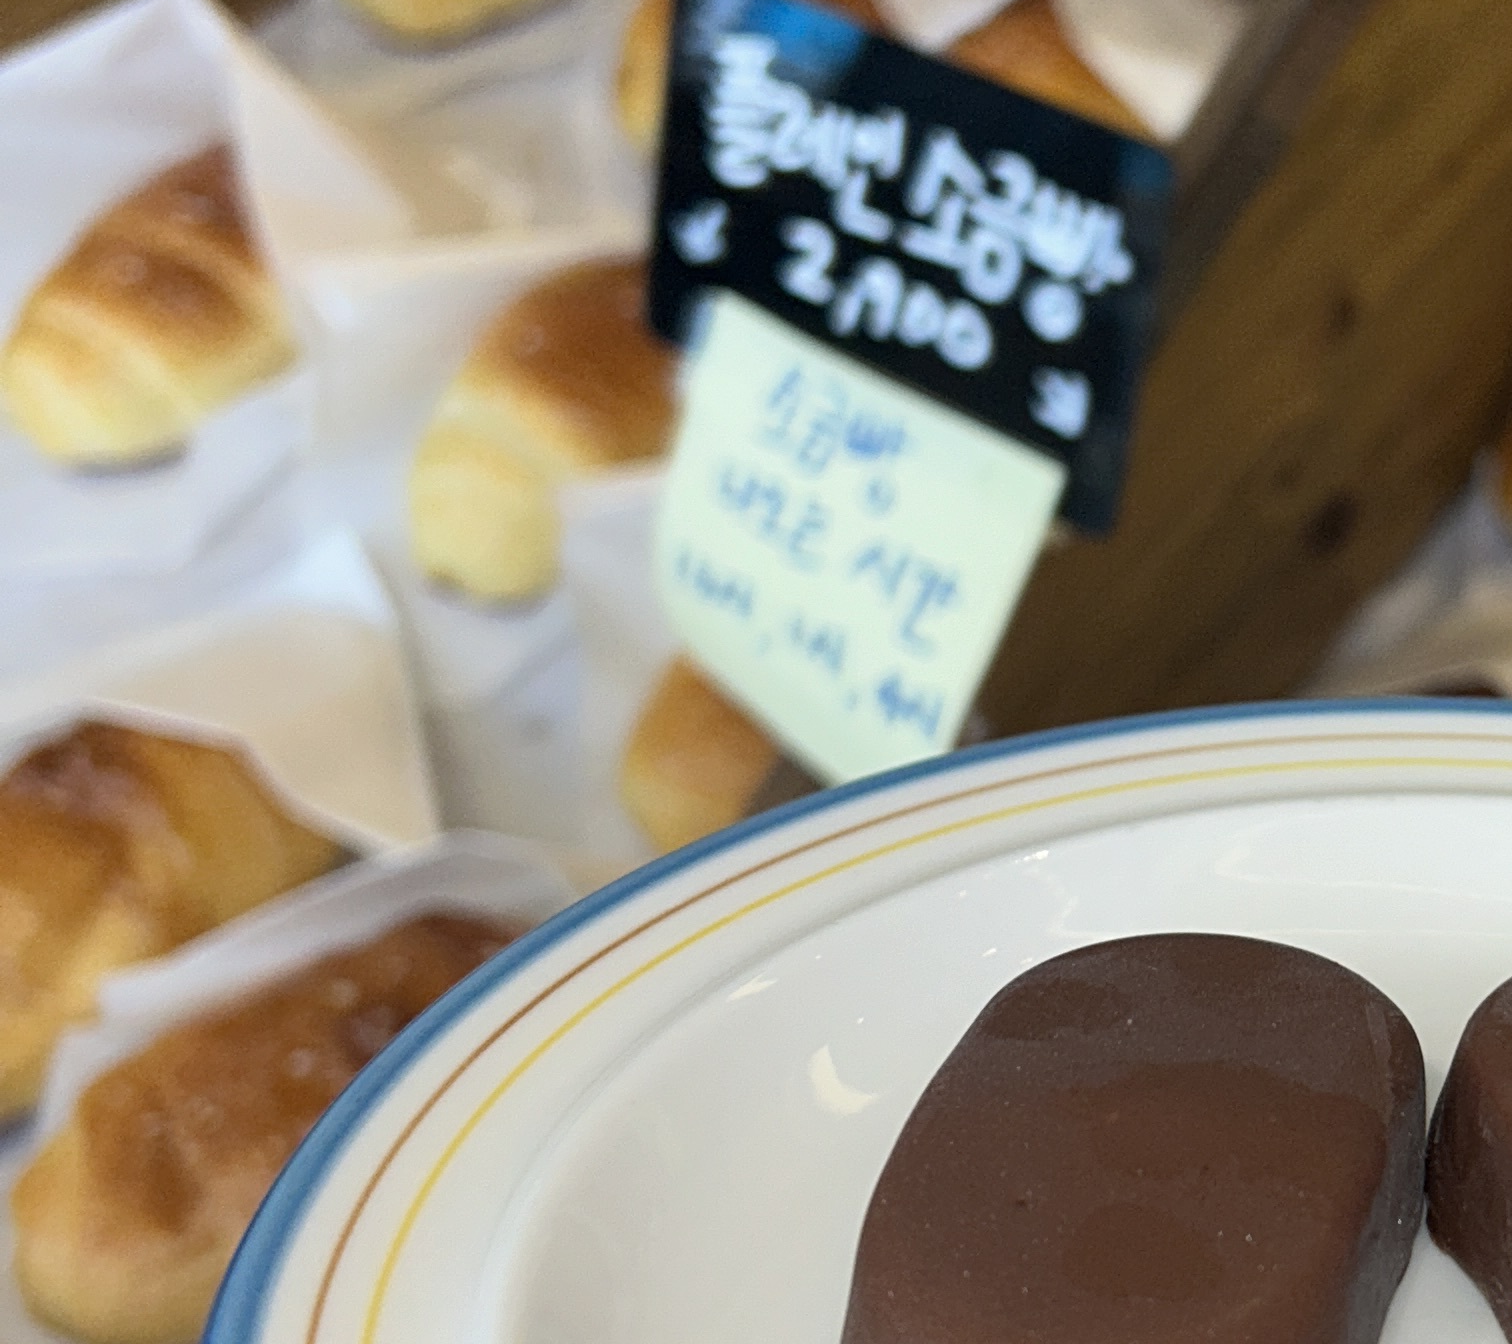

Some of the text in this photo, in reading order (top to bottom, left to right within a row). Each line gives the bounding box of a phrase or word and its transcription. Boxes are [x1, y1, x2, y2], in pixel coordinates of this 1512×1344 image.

[898, 126, 1136, 344] 소금빵
[760, 366, 908, 518] 소금빵
[849, 542, 960, 659] 시간
